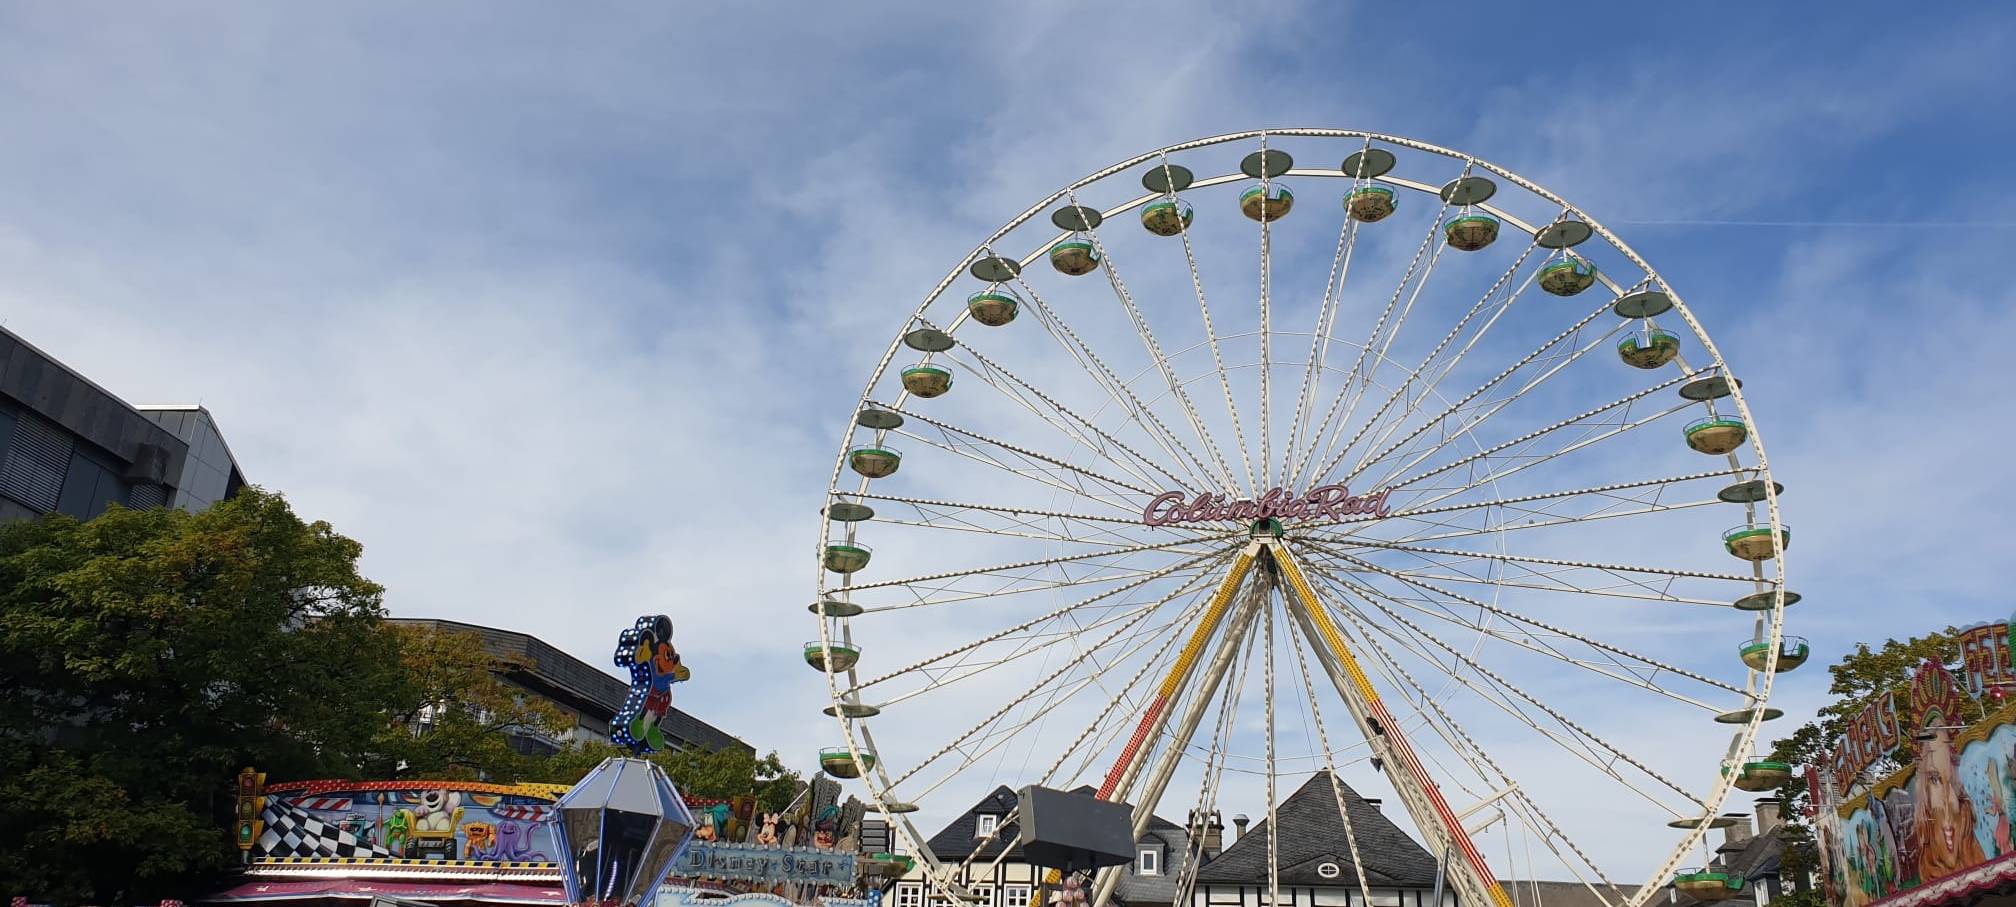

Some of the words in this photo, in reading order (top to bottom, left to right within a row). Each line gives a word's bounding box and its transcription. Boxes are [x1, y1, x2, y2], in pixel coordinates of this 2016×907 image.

[1143, 487, 1309, 526] Columbia
[1307, 485, 1392, 520] Rad
[690, 850, 768, 875] Disney
[782, 855, 833, 873] Star
